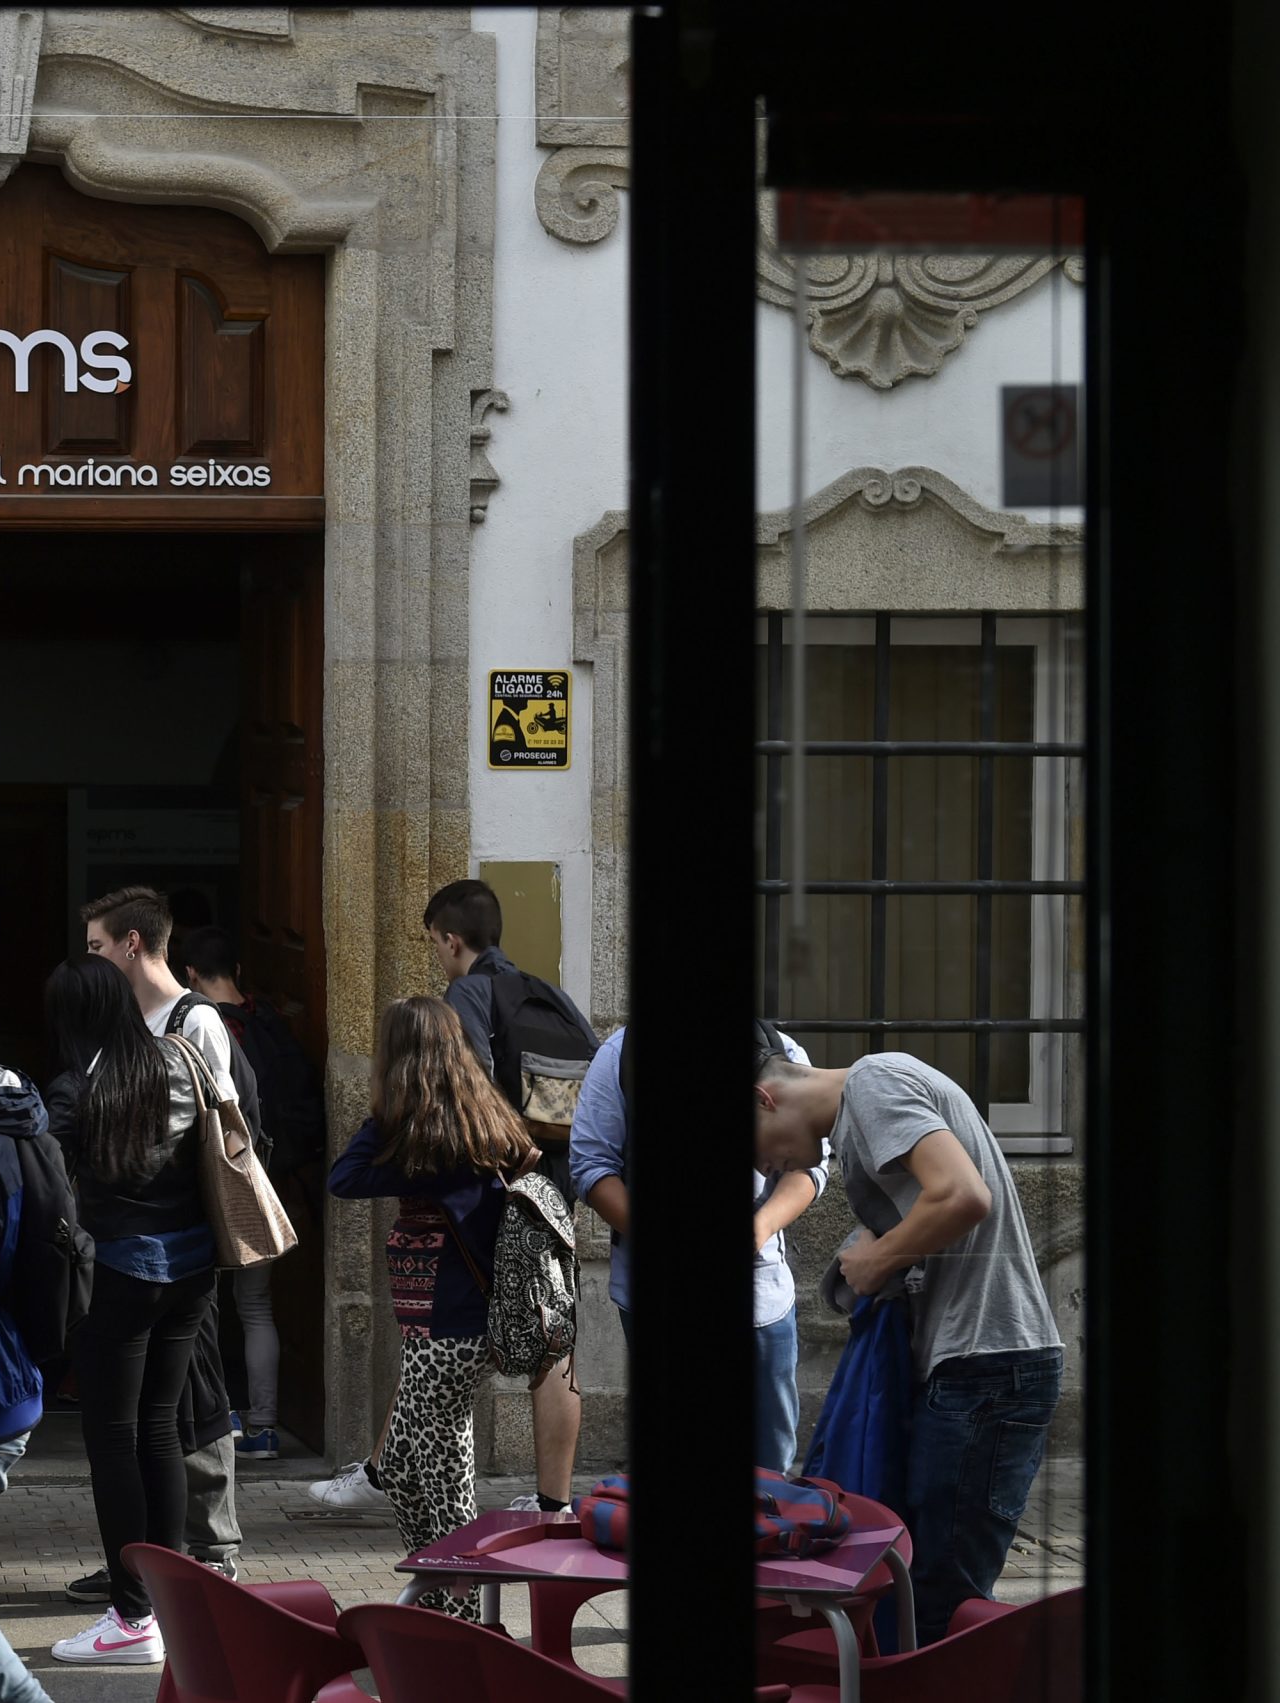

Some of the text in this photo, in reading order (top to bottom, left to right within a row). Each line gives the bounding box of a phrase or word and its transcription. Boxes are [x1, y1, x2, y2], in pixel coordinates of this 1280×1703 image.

[18, 457, 158, 487] mariana
[169, 458, 271, 487] seixas
[495, 674, 543, 684] ALARME
[494, 684, 543, 694] LIGADO
[546, 690, 563, 698] 24h
[513, 752, 557, 760] PROSEGUR
